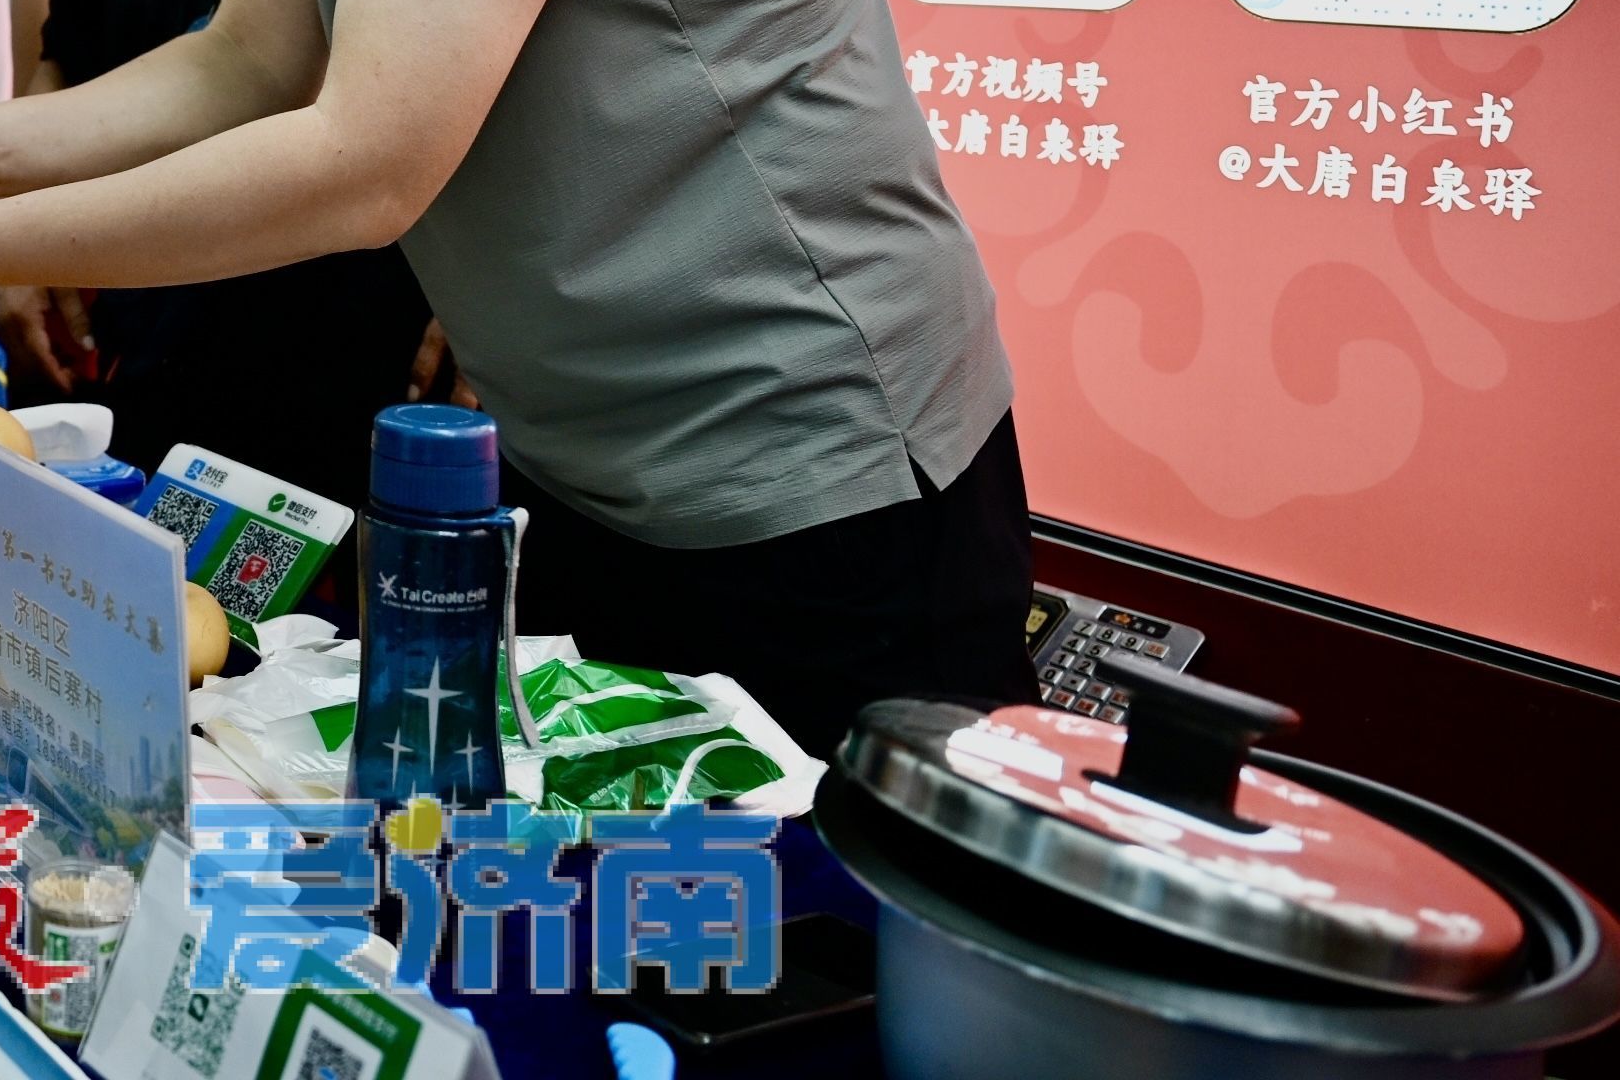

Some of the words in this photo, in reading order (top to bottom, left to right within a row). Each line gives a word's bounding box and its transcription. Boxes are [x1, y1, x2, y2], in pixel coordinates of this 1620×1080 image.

[905, 50, 1108, 108] 官方视频号
[1242, 75, 1514, 148] 官方小红书
[1218, 143, 1543, 221] @大唐白泉驿
[13, 589, 71, 658] 济阳区
[422, 589, 465, 604] Create
